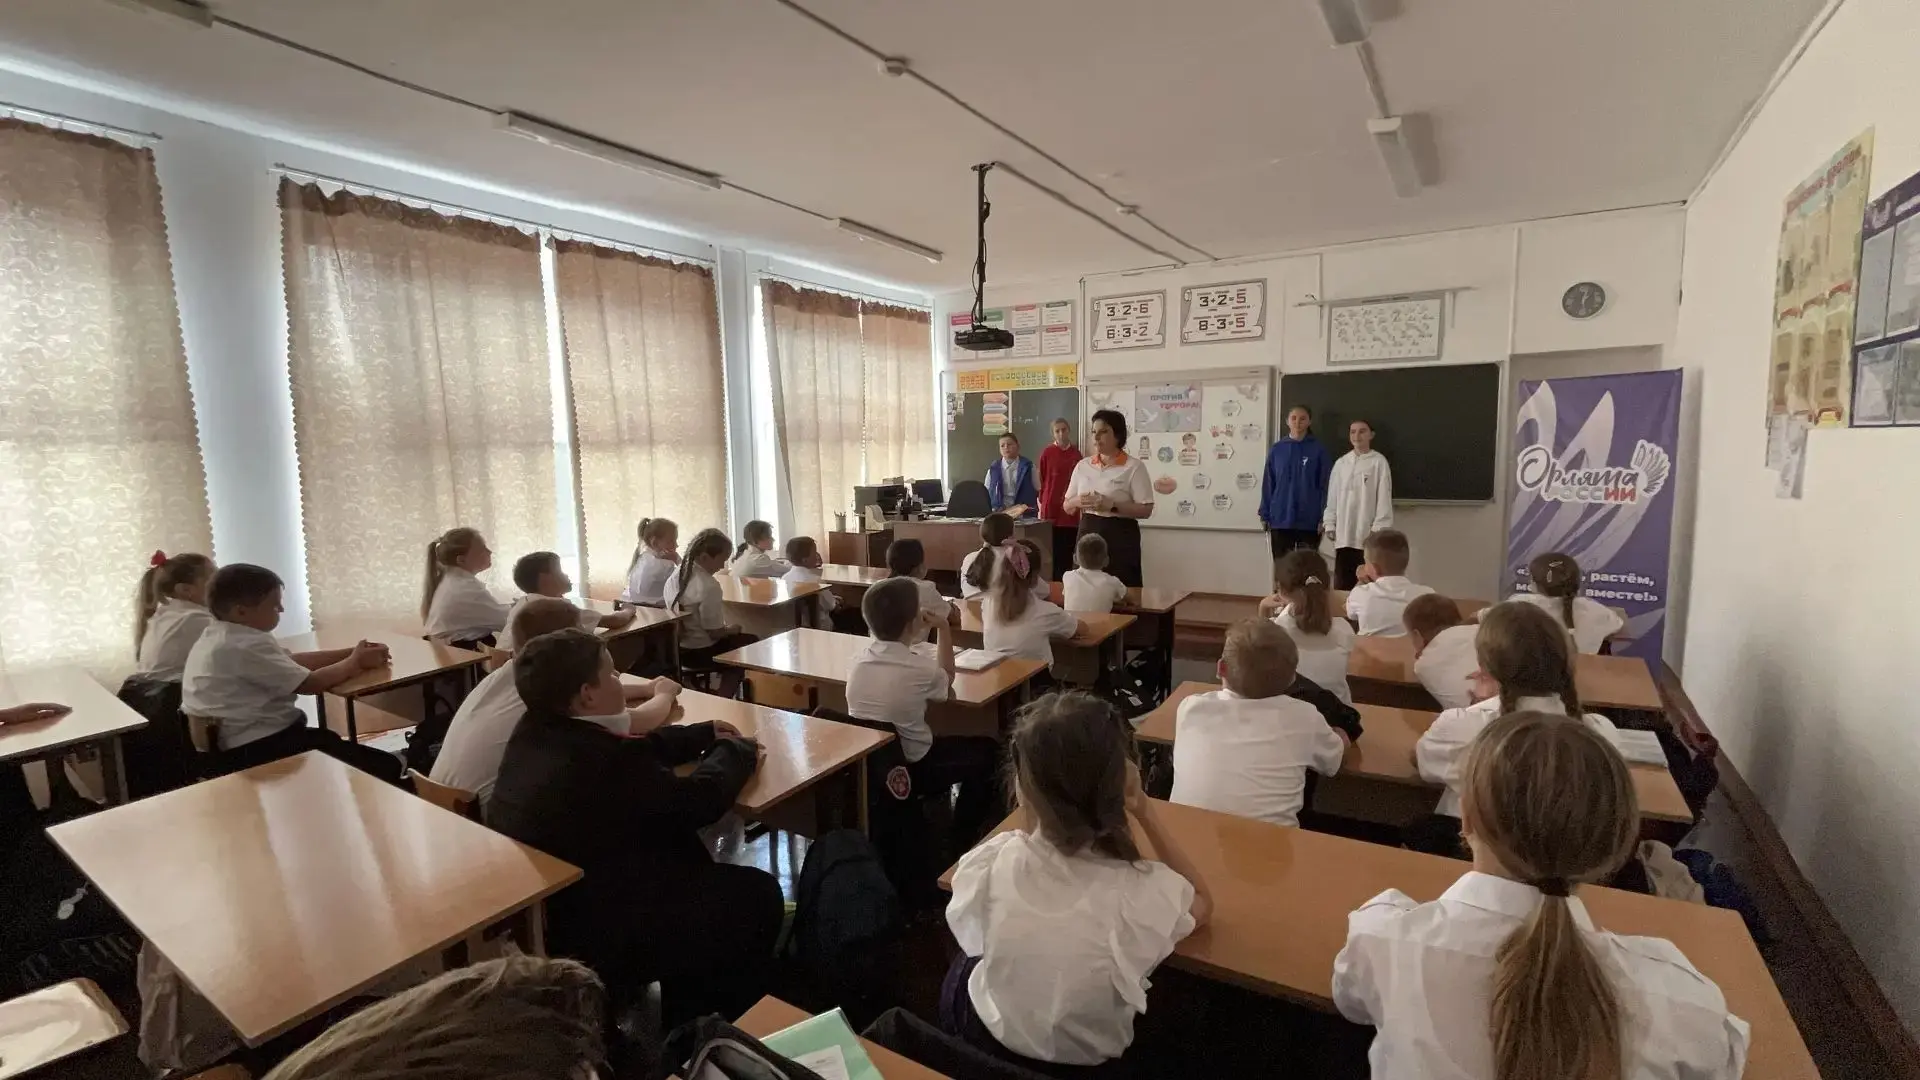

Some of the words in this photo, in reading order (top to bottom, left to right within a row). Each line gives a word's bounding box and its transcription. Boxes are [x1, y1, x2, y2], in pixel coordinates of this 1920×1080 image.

[1520, 446, 1639, 493] Орлята
[1549, 486, 1637, 502] ОССИИ
[1590, 572, 1655, 586] растём,
[1585, 588, 1658, 602] вместе!»
